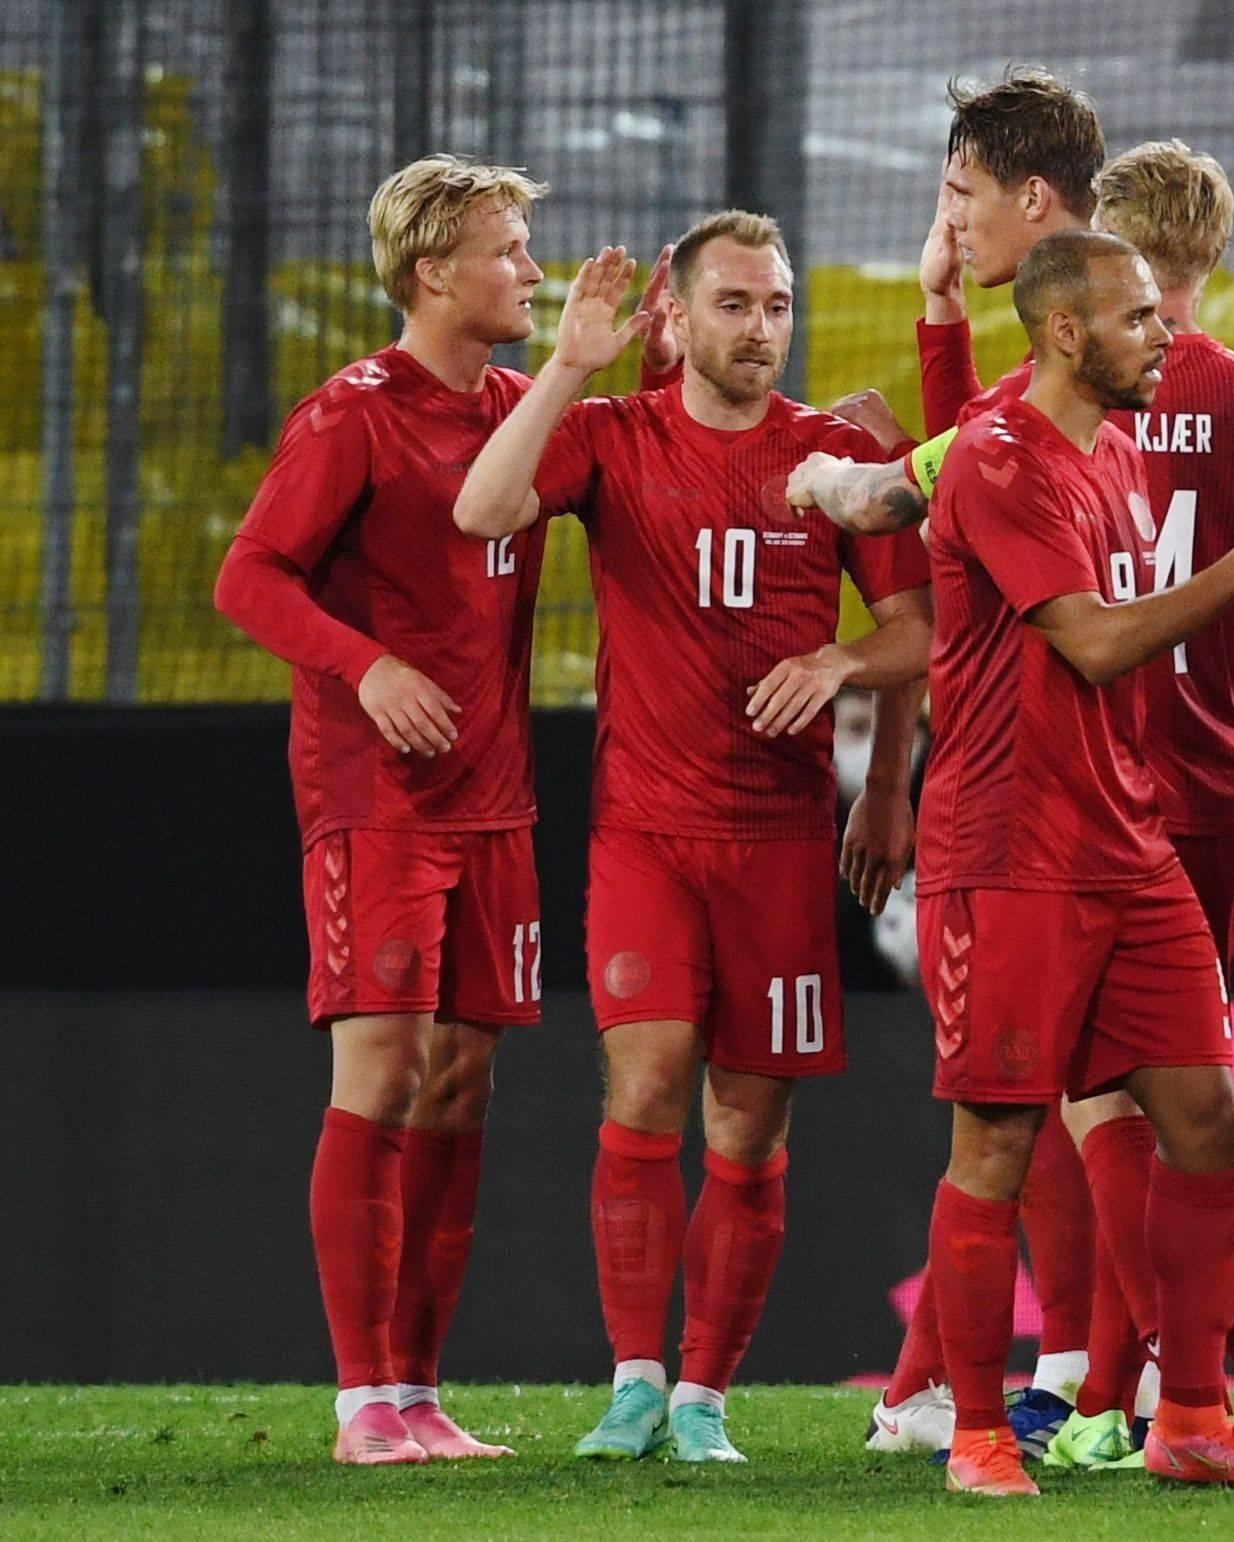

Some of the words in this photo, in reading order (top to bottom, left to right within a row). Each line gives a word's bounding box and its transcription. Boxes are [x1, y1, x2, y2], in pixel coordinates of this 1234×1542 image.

[1134, 412, 1212, 453] KJÆR
[695, 527, 756, 608] 10
[512, 920, 542, 1003] 12
[767, 973, 824, 1054] 10
